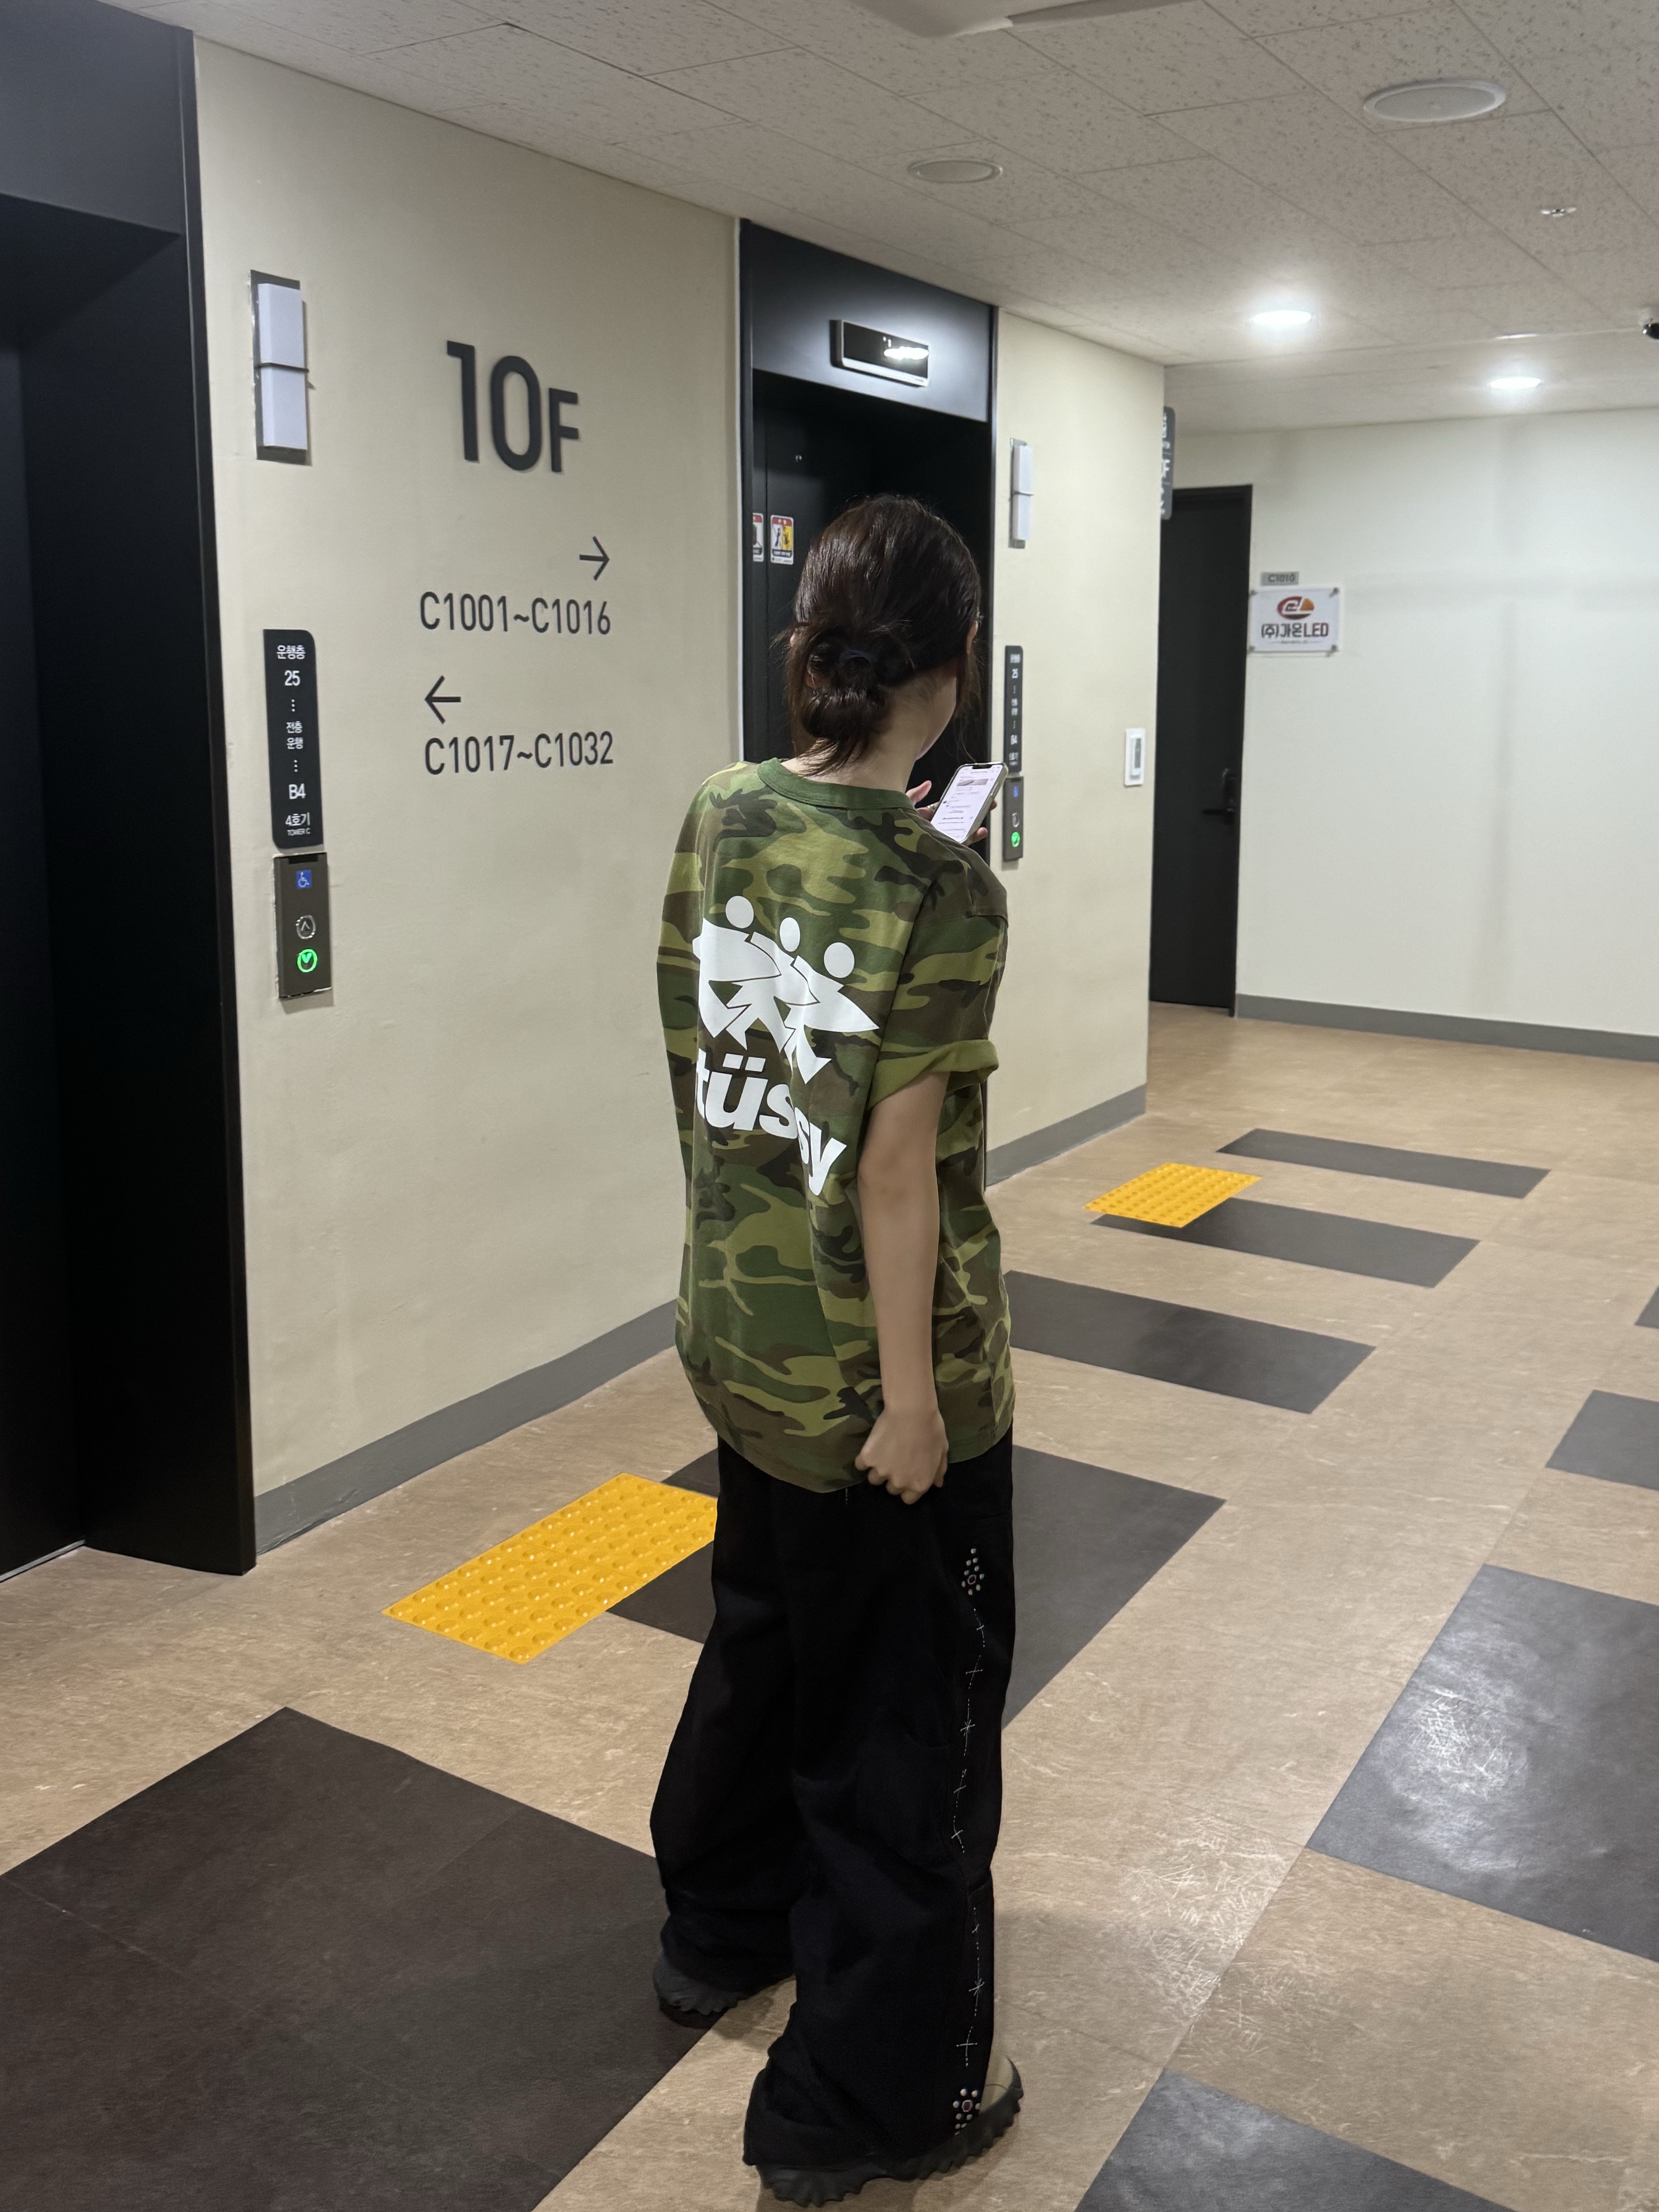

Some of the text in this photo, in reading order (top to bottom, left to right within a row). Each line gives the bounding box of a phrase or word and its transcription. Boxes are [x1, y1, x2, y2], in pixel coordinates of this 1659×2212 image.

[447, 341, 579, 472] 10F
[420, 591, 610, 635] C1001~C1016
[285, 670, 301, 686] 25
[425, 731, 613, 775] C1017~C1032
[289, 783, 306, 799] B4
[285, 812, 310, 826] 4호기
